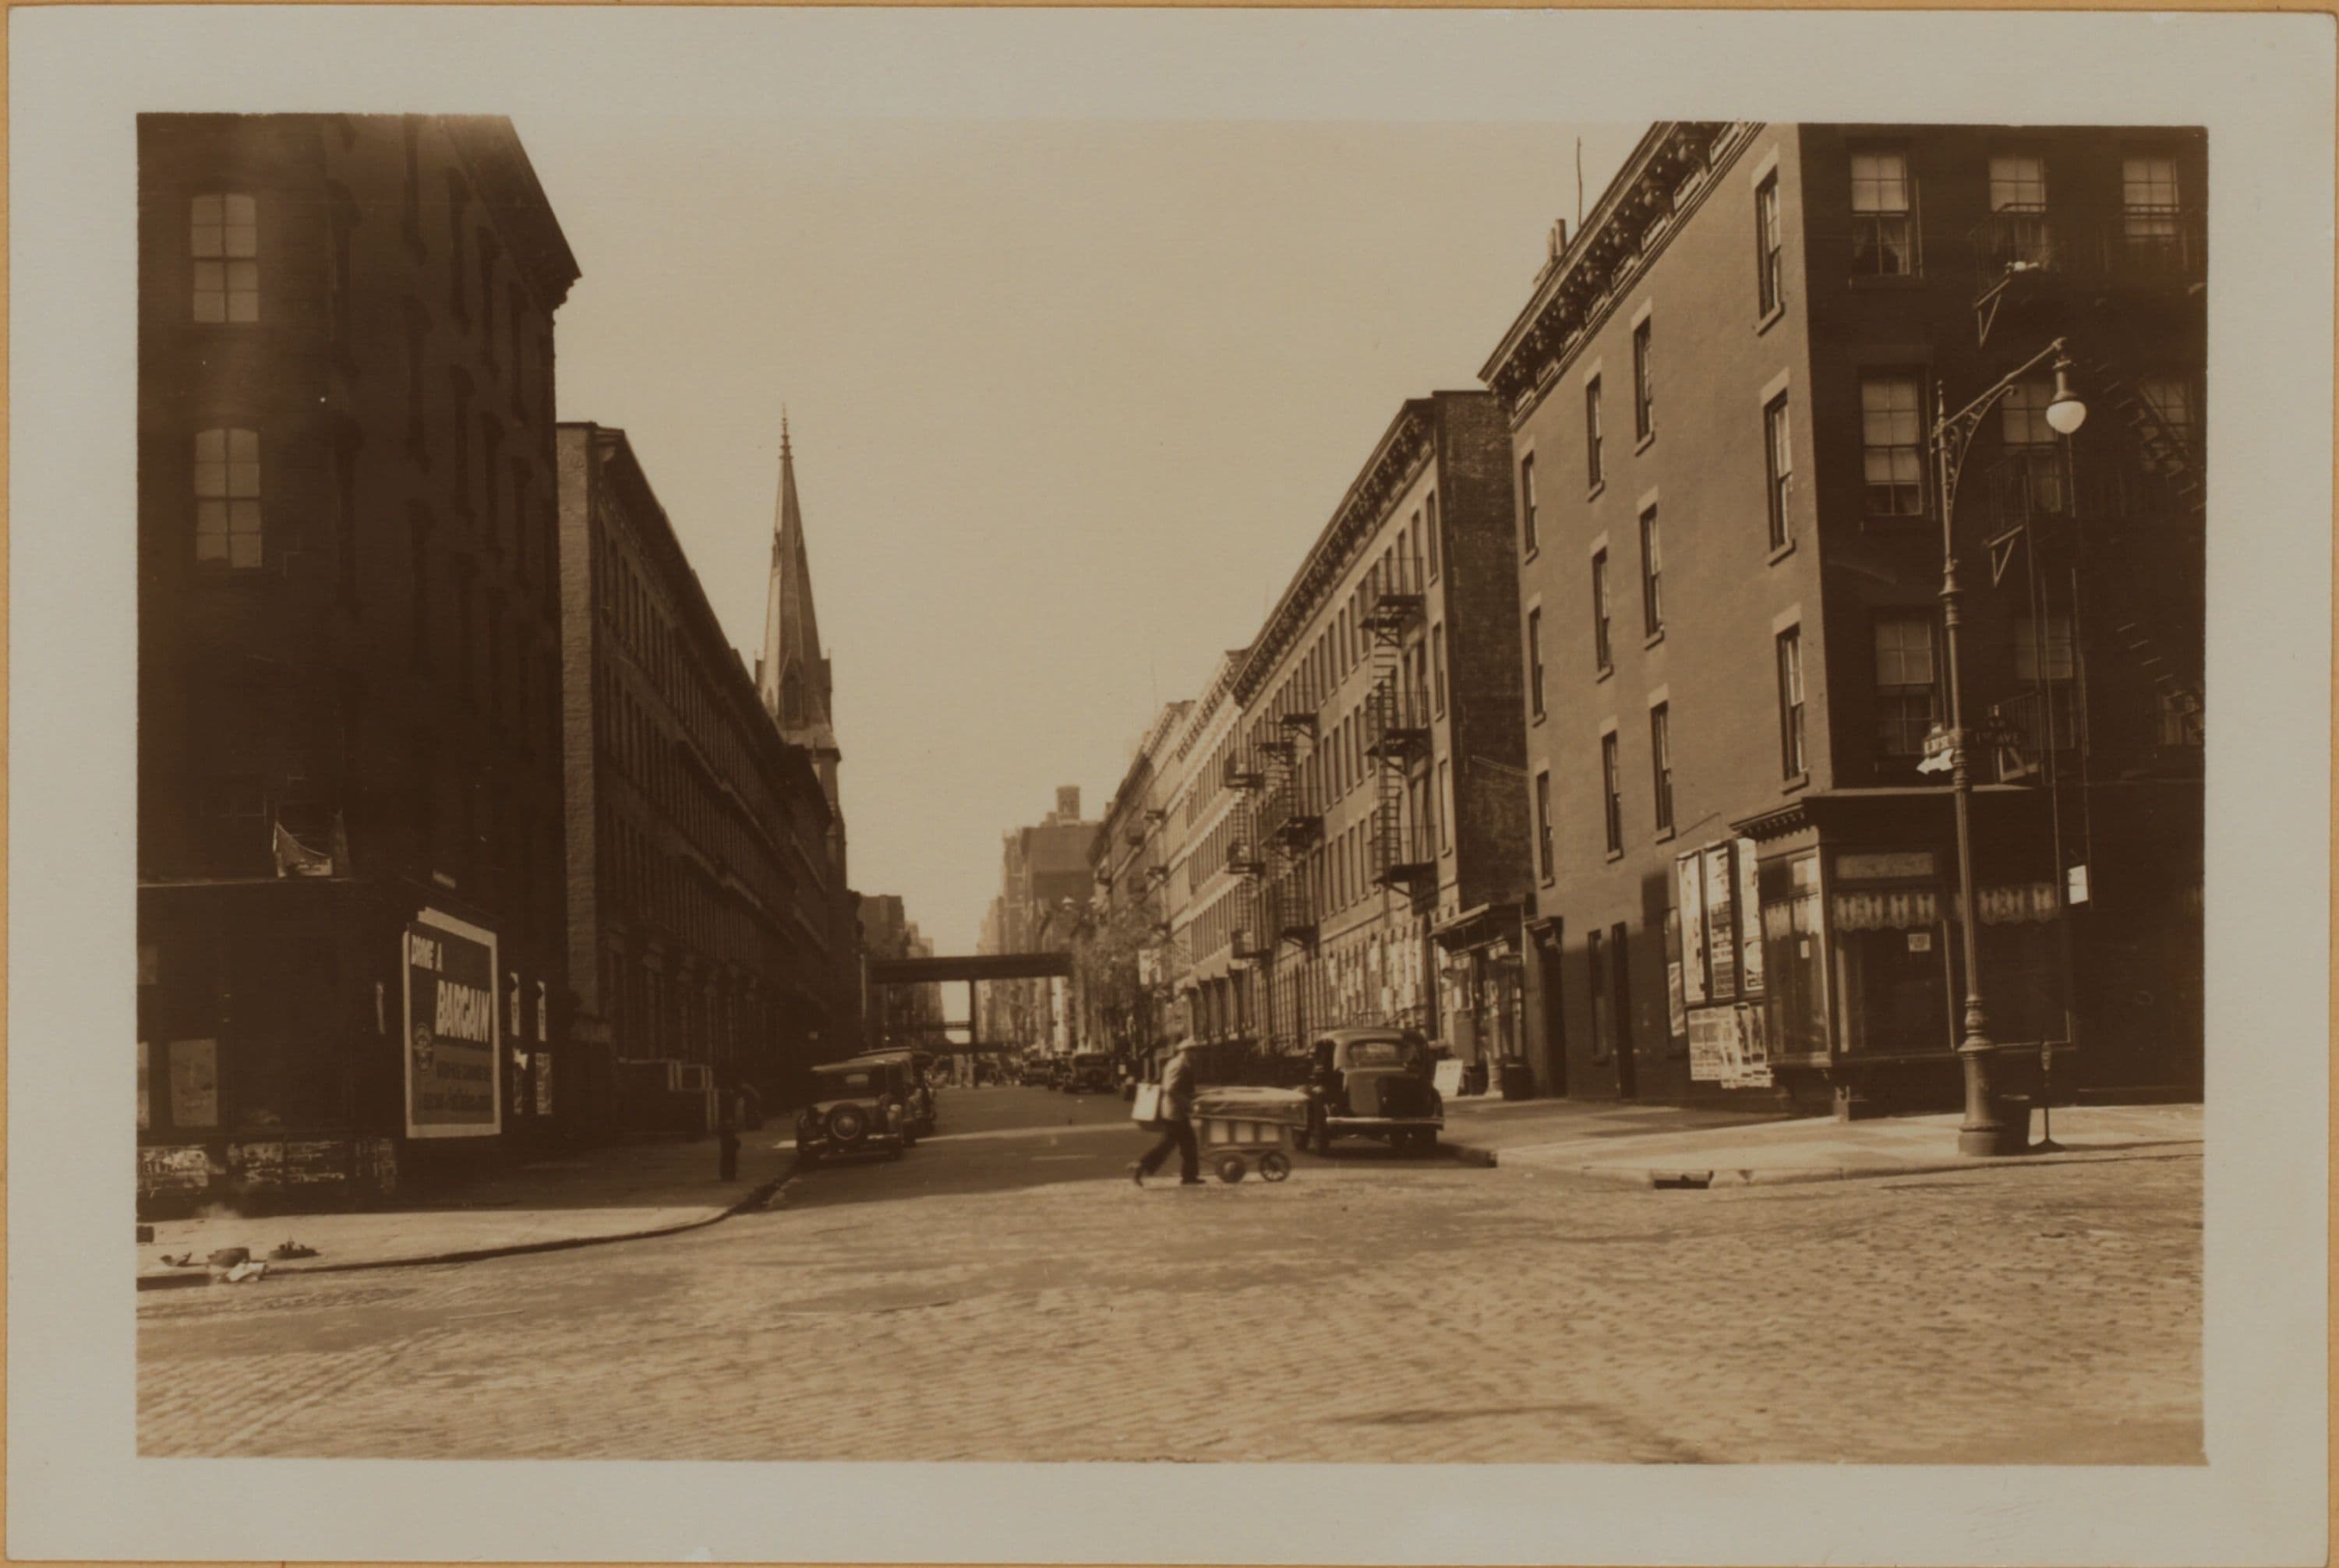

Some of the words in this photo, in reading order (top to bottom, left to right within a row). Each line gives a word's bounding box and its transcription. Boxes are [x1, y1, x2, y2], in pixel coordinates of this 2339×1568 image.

[1996, 732, 2020, 745] AVE
[411, 934, 434, 969] DRIVE
[436, 942, 443, 972] A
[435, 979, 491, 1043] BARGAIN
